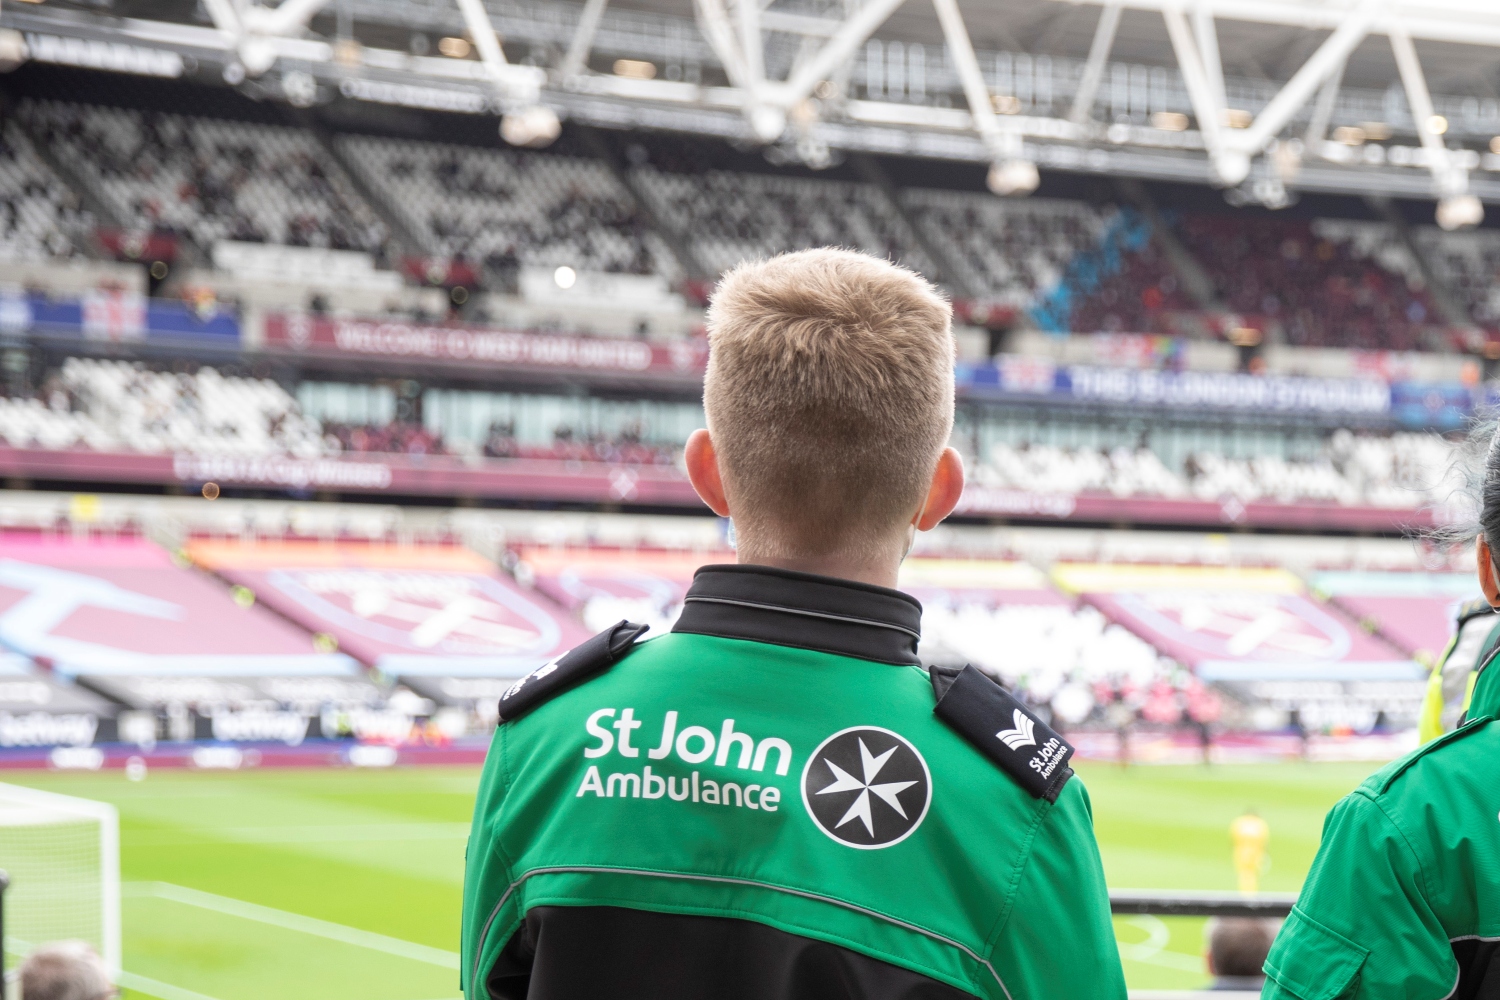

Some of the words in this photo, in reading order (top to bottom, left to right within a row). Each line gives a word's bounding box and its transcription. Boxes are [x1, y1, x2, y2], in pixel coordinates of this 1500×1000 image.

[584, 708, 642, 758] St
[648, 710, 792, 776] John
[1037, 737, 1060, 762] John
[1029, 756, 1046, 773] St
[1040, 745, 1068, 780] Ambulance
[576, 765, 781, 812] Ambulance
